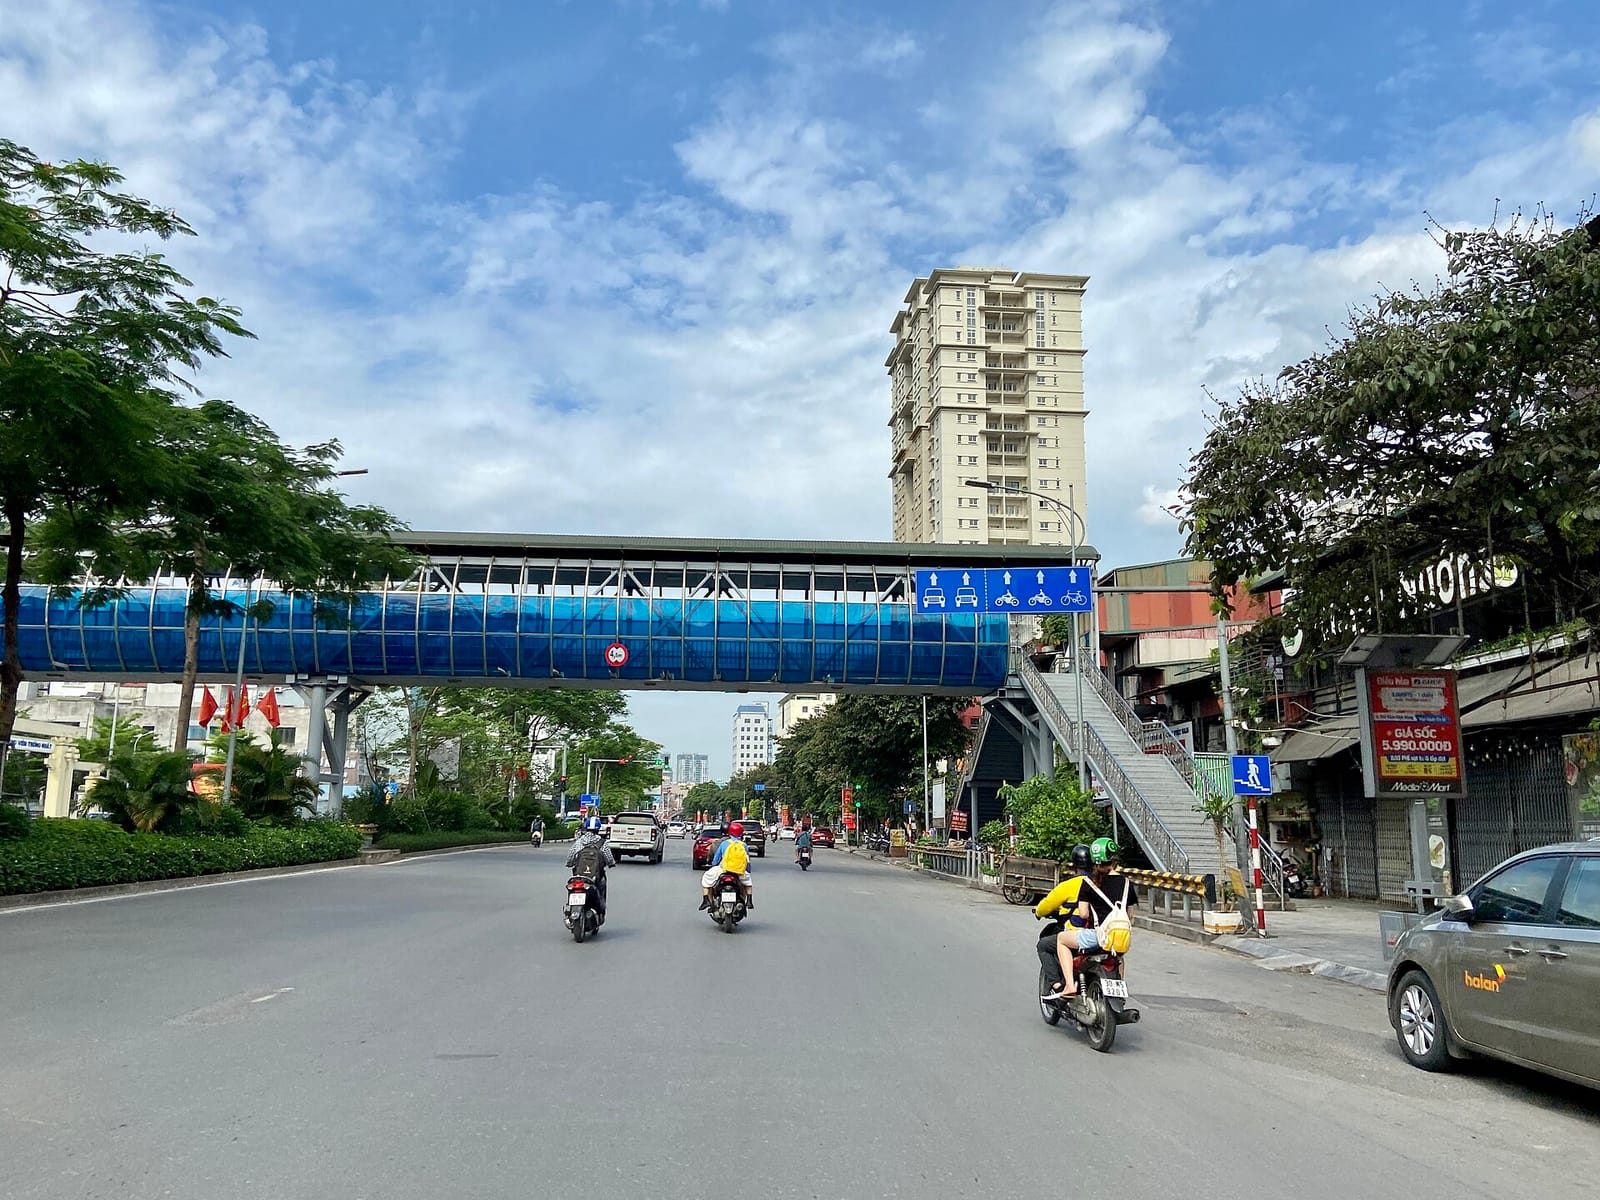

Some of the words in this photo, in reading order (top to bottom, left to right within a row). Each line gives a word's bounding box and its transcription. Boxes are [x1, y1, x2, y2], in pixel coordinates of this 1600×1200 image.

[1394, 726, 1414, 738] GIÁ
[1414, 725, 1437, 739] SỐC
[1391, 782, 1420, 792] Media
[1427, 782, 1450, 792] Mart
[1464, 969, 1500, 993] halan
